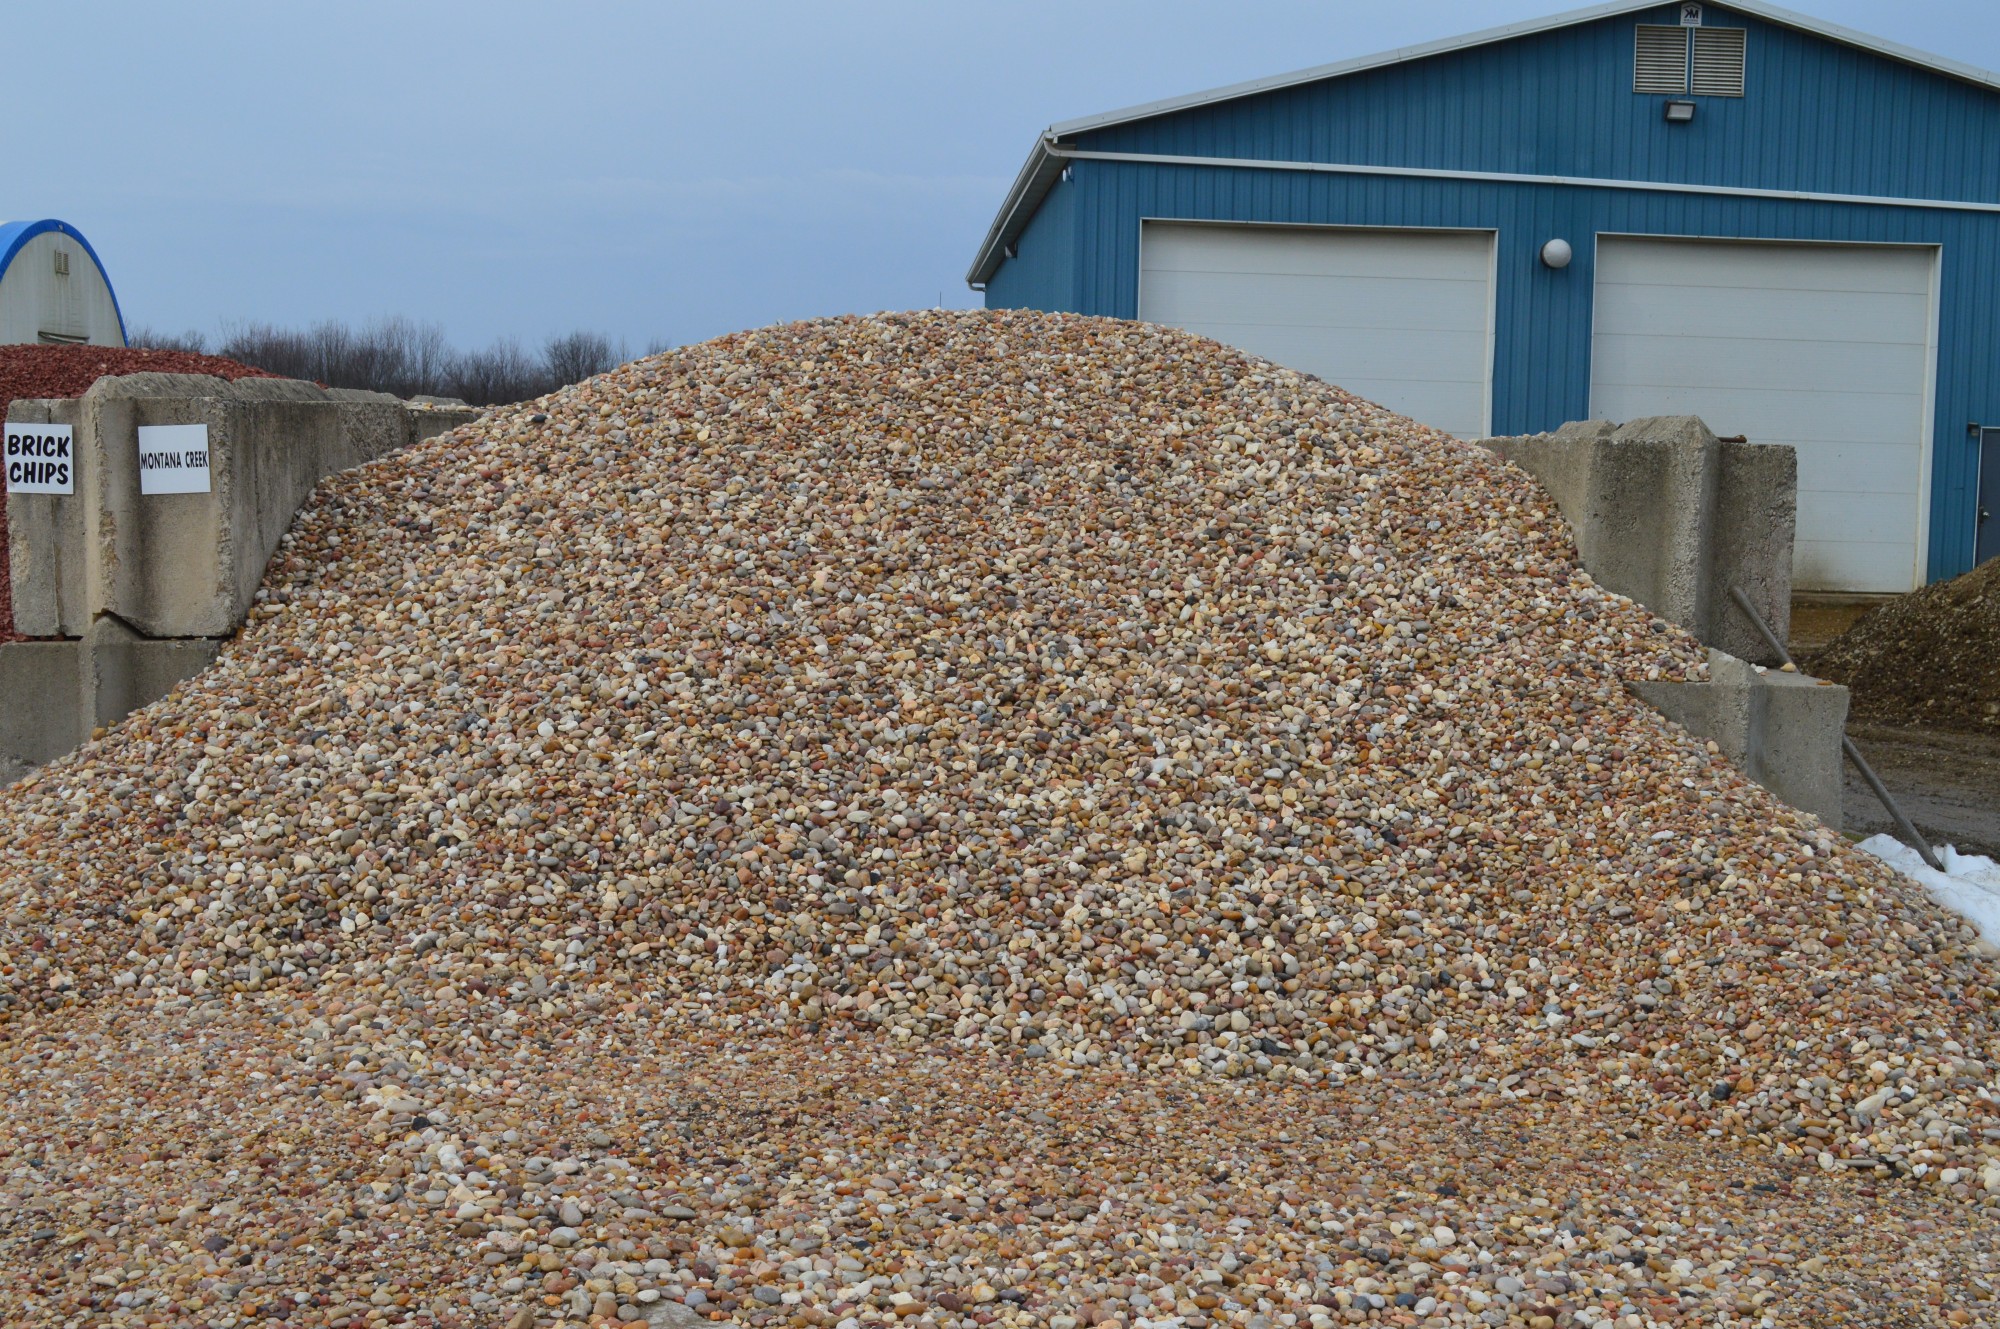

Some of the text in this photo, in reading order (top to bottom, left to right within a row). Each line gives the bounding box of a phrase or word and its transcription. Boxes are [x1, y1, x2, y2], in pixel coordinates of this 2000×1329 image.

[8, 435, 70, 457] BRICK
[140, 451, 209, 469] MONTANA CREEK
[9, 462, 69, 485] CHIPS
